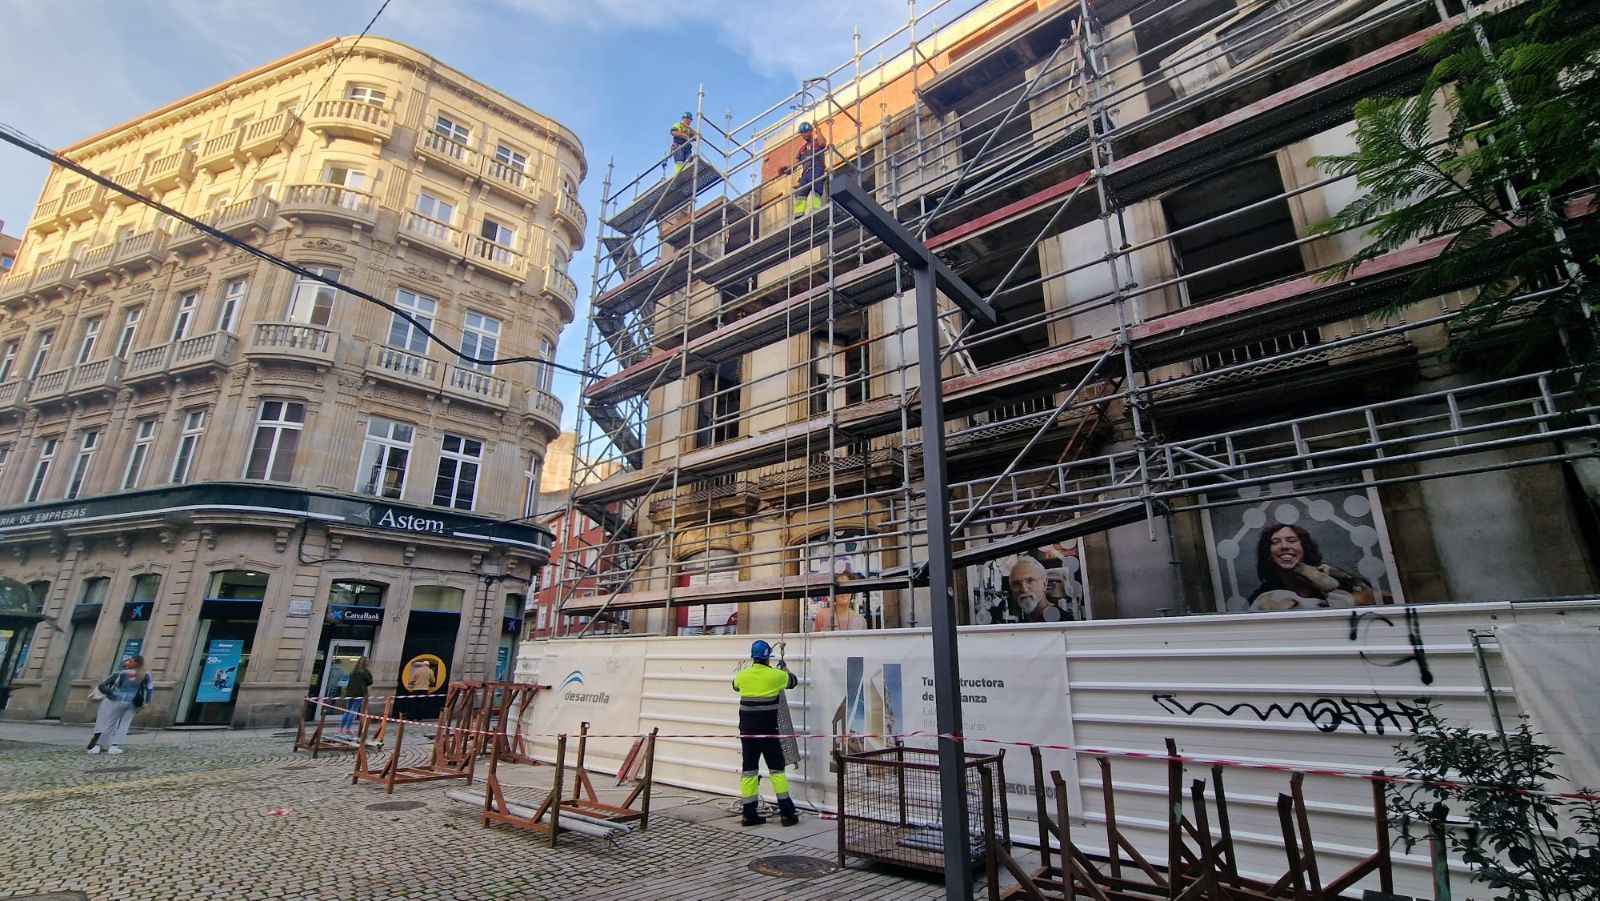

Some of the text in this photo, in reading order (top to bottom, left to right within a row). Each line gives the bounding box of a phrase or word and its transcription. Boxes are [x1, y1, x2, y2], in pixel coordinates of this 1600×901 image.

[19, 514, 32, 524] DE
[36, 508, 87, 521] EMPRESAS
[377, 508, 444, 533] Astem
[344, 610, 380, 621] CaixaBank
[922, 677, 1005, 688] Tu tructora
[564, 690, 610, 704] desarrolla
[922, 692, 934, 702] de
